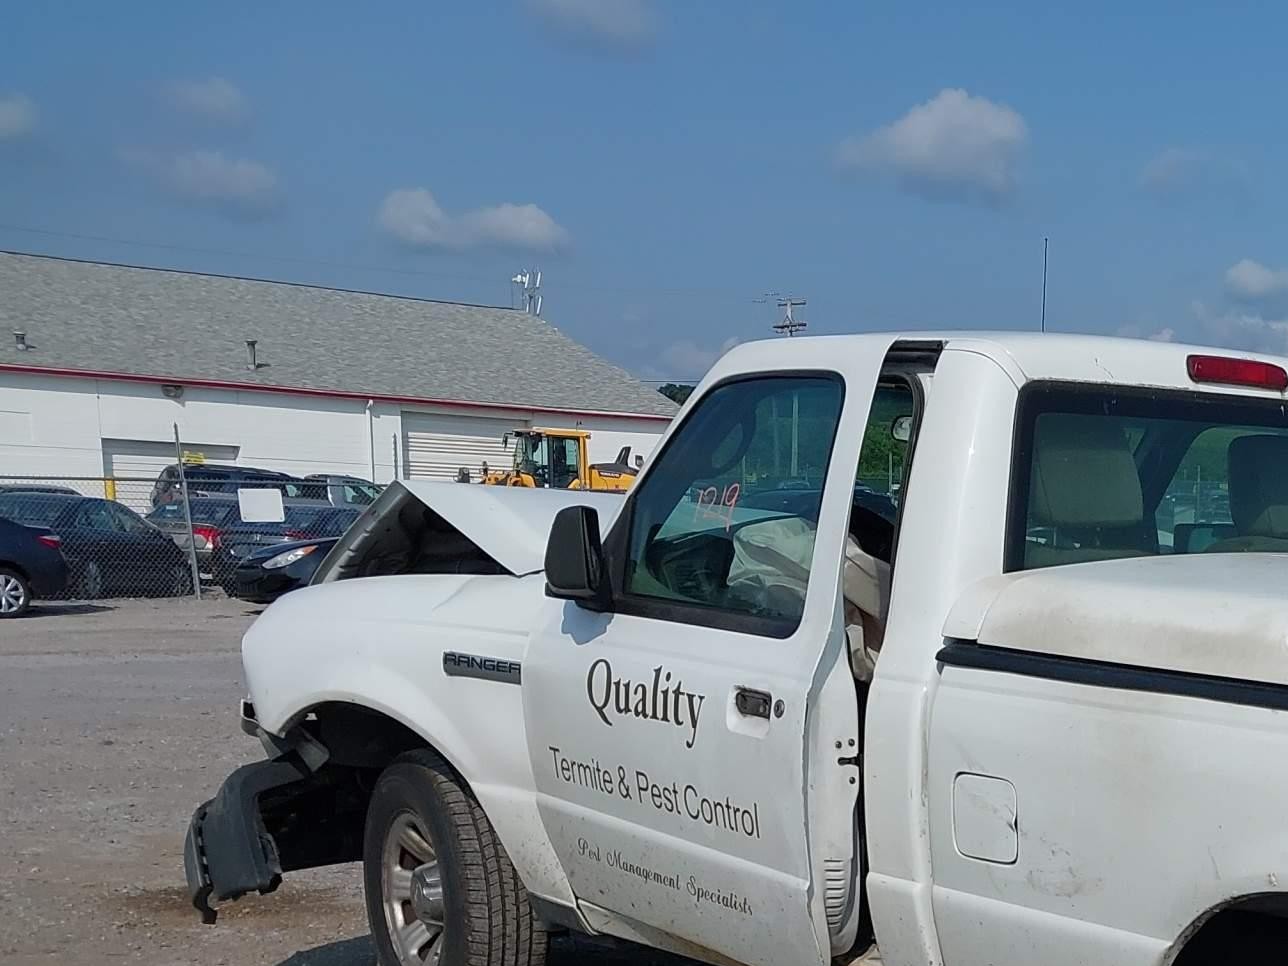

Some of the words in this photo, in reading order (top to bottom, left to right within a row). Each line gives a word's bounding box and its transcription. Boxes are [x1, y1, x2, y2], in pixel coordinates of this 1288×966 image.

[444, 653, 522, 675] RANGER
[587, 658, 705, 748] Quality
[549, 746, 614, 794] Termite
[617, 765, 632, 801] &
[635, 770, 681, 815] Pest
[683, 784, 760, 839] Control
[577, 837, 601, 862] Pest
[606, 850, 681, 890] Management
[686, 875, 753, 916] Specialists
